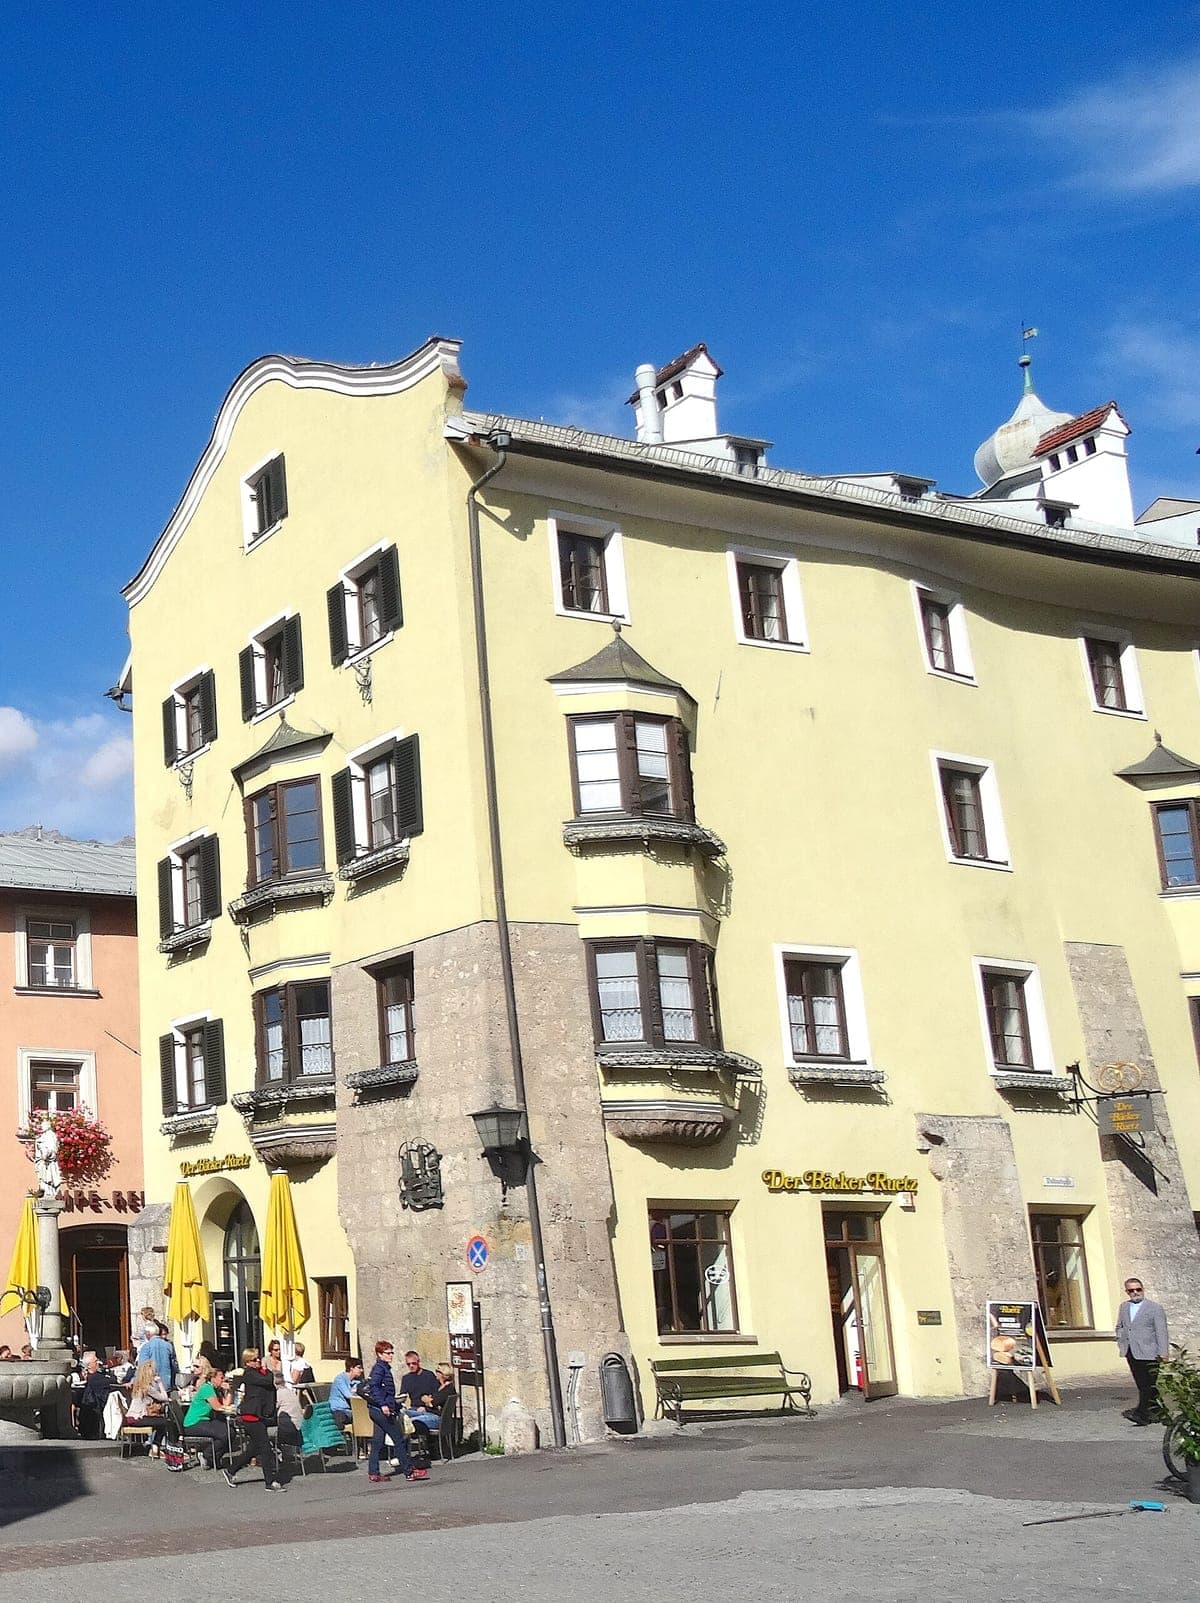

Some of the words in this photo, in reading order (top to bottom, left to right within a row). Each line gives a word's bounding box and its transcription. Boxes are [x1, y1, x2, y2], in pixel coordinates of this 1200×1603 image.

[762, 1169, 802, 1190] Der
[803, 1170, 867, 1192] Bäcker
[867, 1171, 918, 1193] Ruetz
